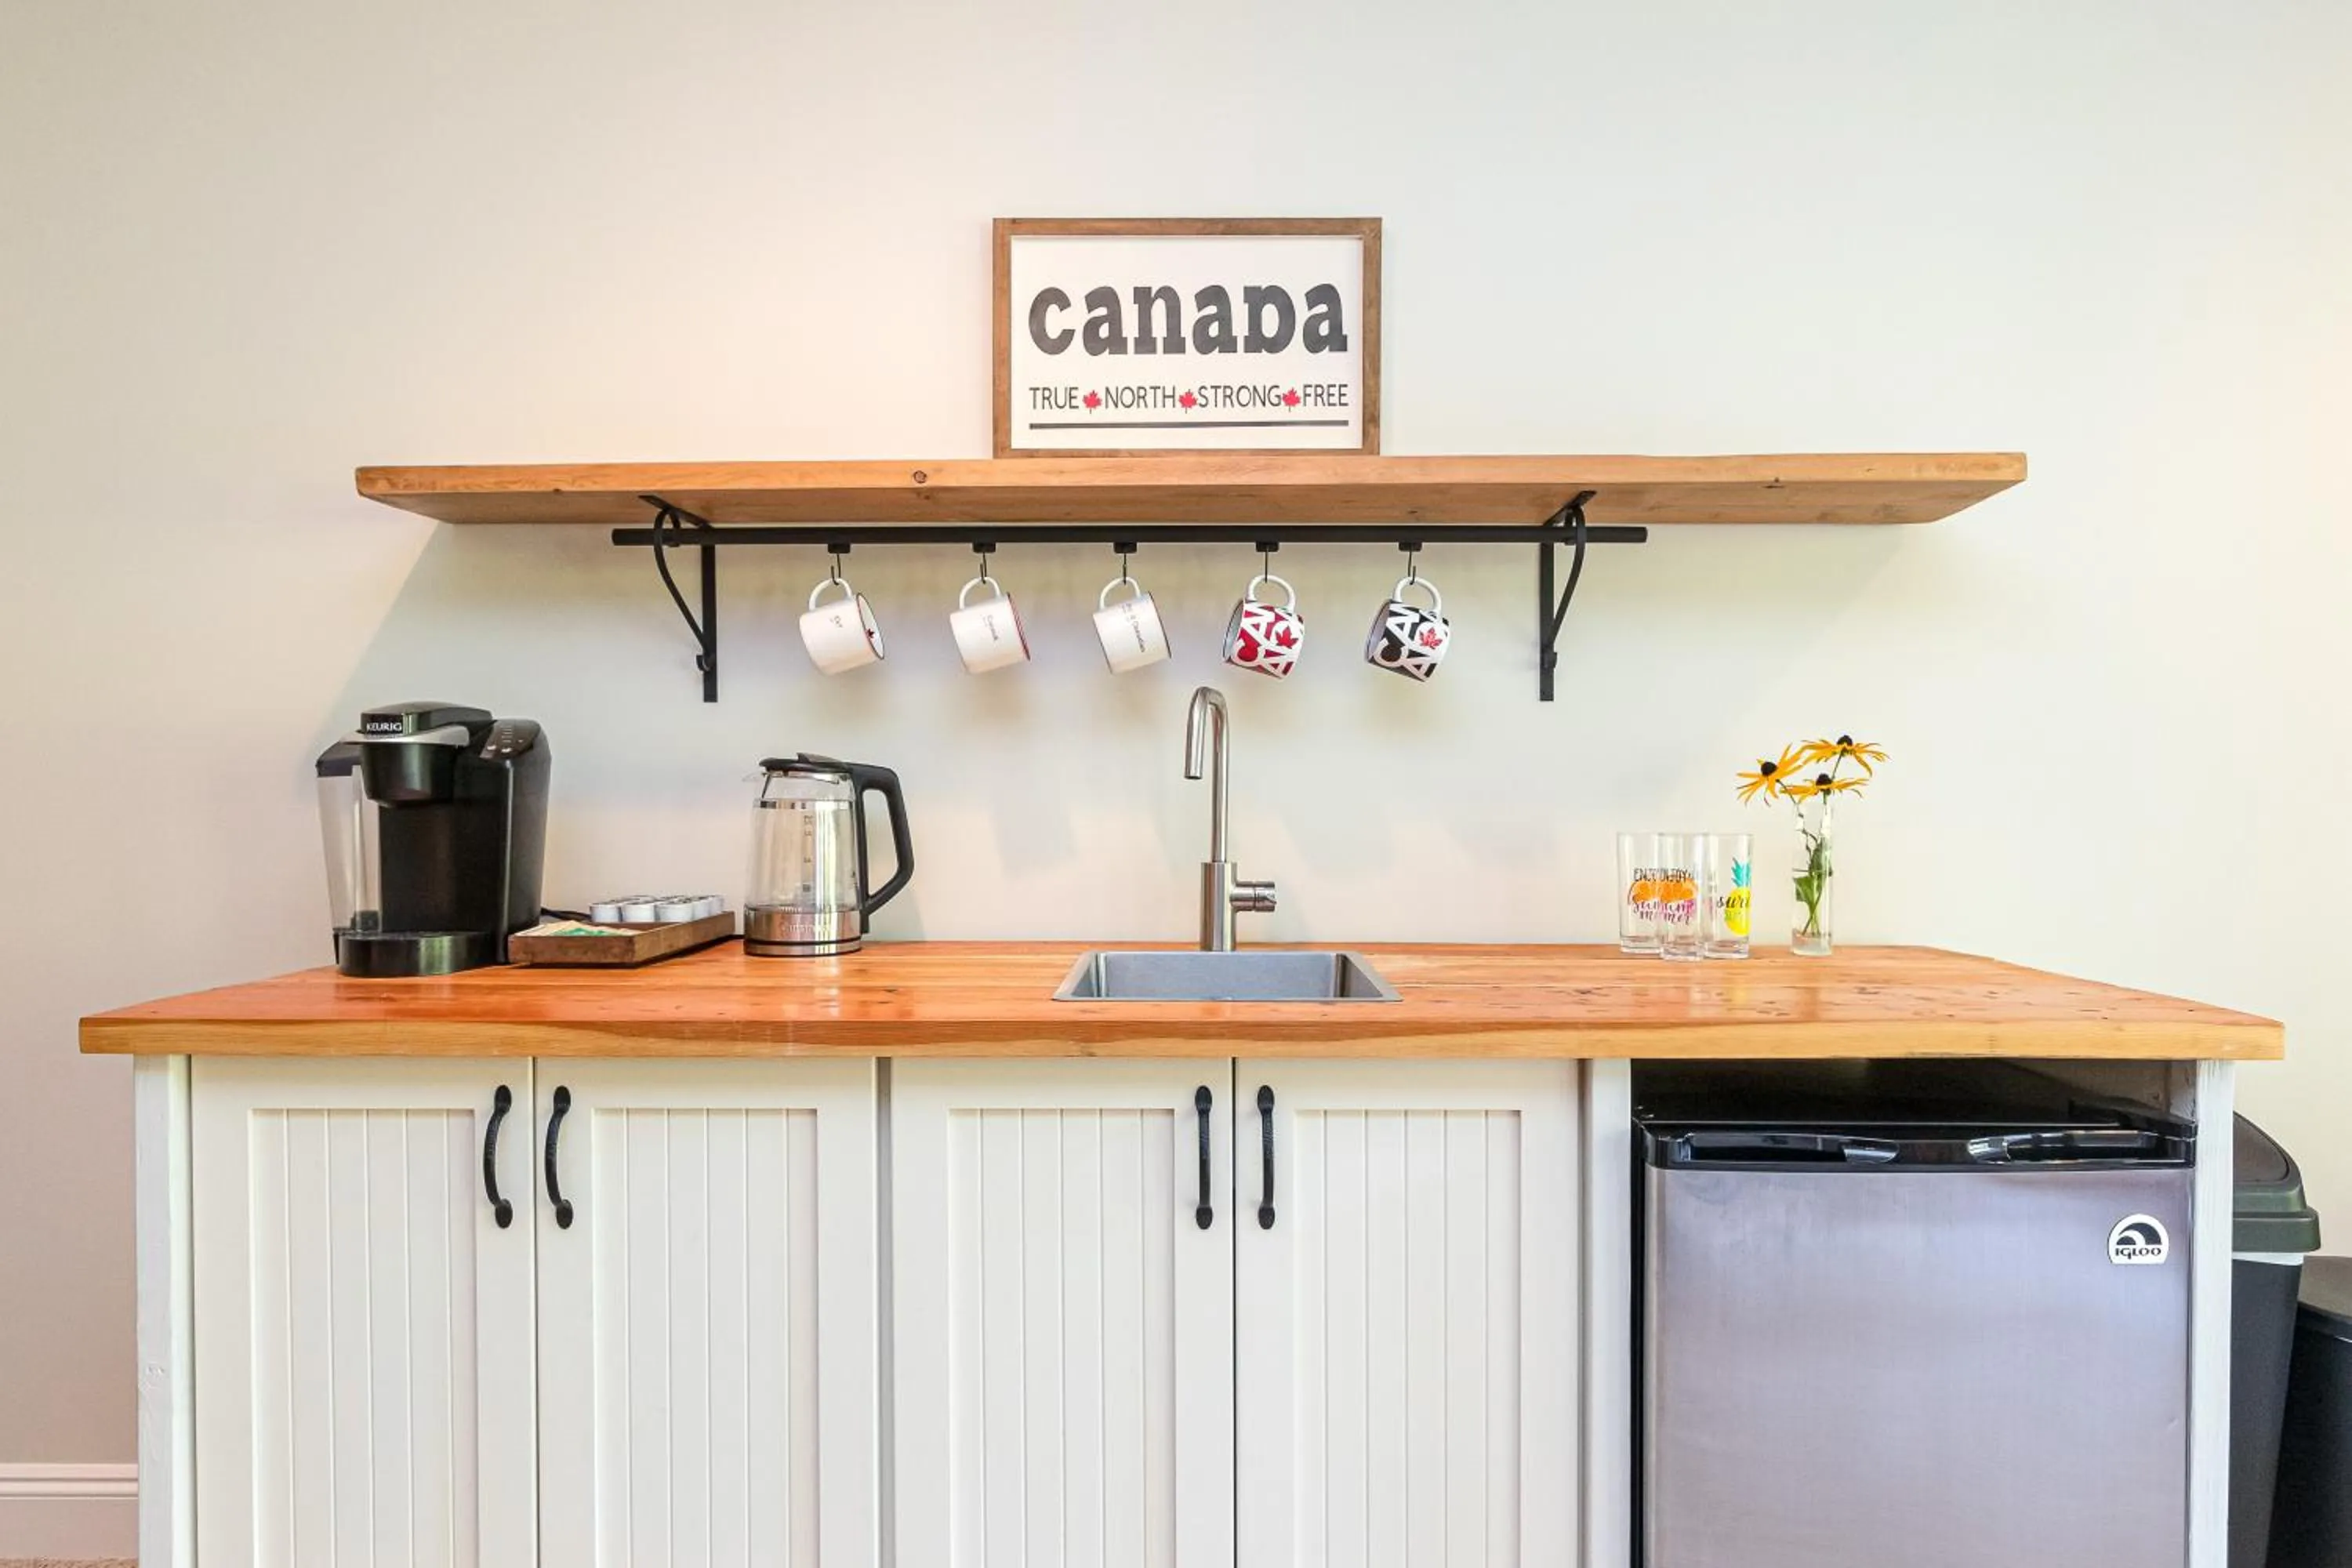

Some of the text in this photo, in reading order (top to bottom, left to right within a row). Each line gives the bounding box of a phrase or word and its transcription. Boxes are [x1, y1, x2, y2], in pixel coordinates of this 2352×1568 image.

[1029, 383, 1349, 409] TRUE NORTH STRONG FREE
[366, 722, 402, 731] KEURIG
[2114, 1247, 2161, 1260] IGLOO
